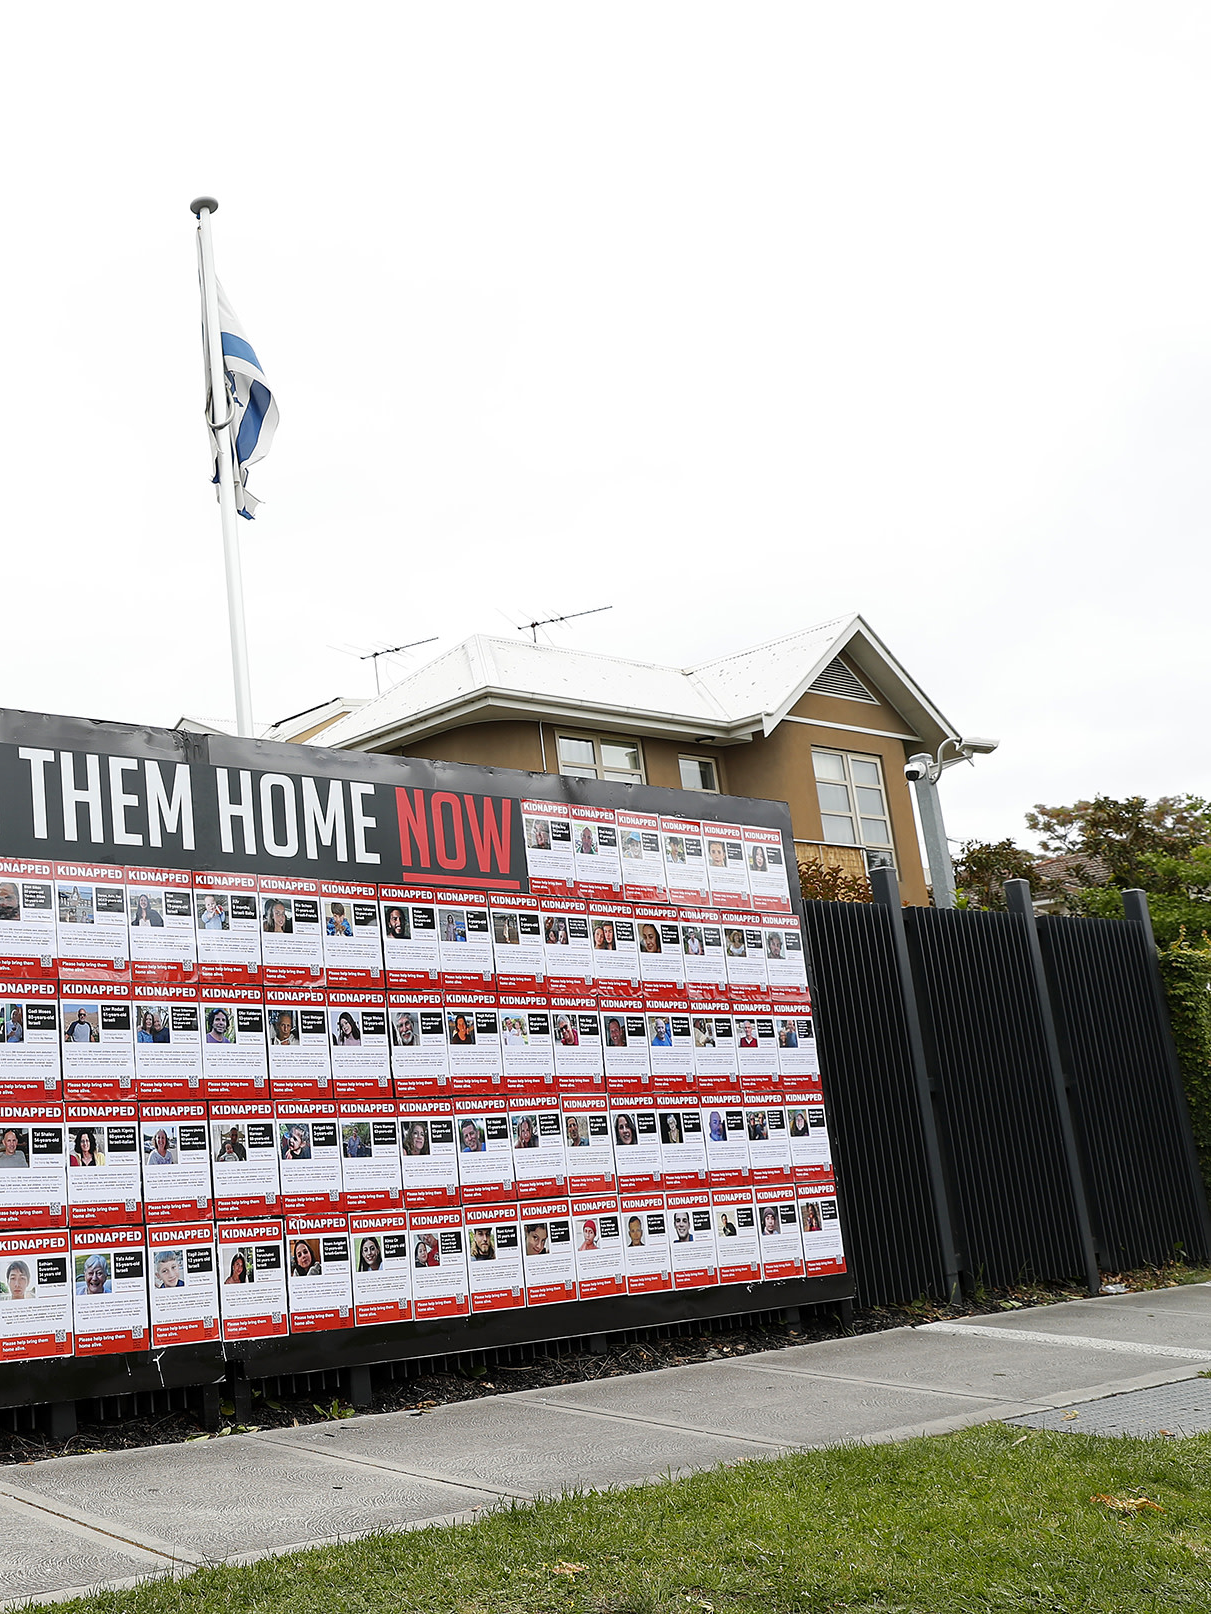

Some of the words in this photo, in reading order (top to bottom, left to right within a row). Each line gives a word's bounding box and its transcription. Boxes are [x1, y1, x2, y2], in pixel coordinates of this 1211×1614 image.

[19, 747, 195, 850] THEM
[216, 768, 380, 864] HOME
[395, 787, 511, 873] NOW
[571, 807, 615, 821] KIDNAPPED
[661, 821, 700, 833] KIDNAPPED
[744, 831, 780, 842] KIDNAPPED
[128, 870, 189, 884] KIDNAPPED
[195, 874, 255, 888] KIDNAPPED
[260, 878, 317, 892] KIDNAPPED
[381, 888, 433, 900] KIDNAPPED
[490, 895, 538, 907] KIDNAPPED
[589, 903, 632, 915] KIDNAPPED
[679, 910, 719, 921] KIDNAPPED
[134, 986, 196, 997] KIDNAPPED
[266, 989, 324, 1002] KIDNAPPED
[445, 994, 496, 1004] KIDNAPPED
[499, 996, 547, 1006] KIDNAPPED
[600, 999, 643, 1009] KIDNAPPED
[690, 1002, 730, 1011] KIDNAPPED
[509, 1096, 558, 1108] KIDNAPPED
[785, 1093, 823, 1102] KIDNAPPED
[277, 1104, 335, 1114] KIDNAPPED
[340, 1103, 395, 1113] KIDNAPPED
[455, 1099, 505, 1110] KIDNAPPED
[142, 1105, 204, 1117] KIDNAPPED
[756, 1189, 794, 1200] KIDNAPPED
[466, 1208, 516, 1221] KIDNAPPED
[352, 1217, 405, 1229] KIDNAPPED
[74, 1230, 142, 1245] KIDNAPPED
